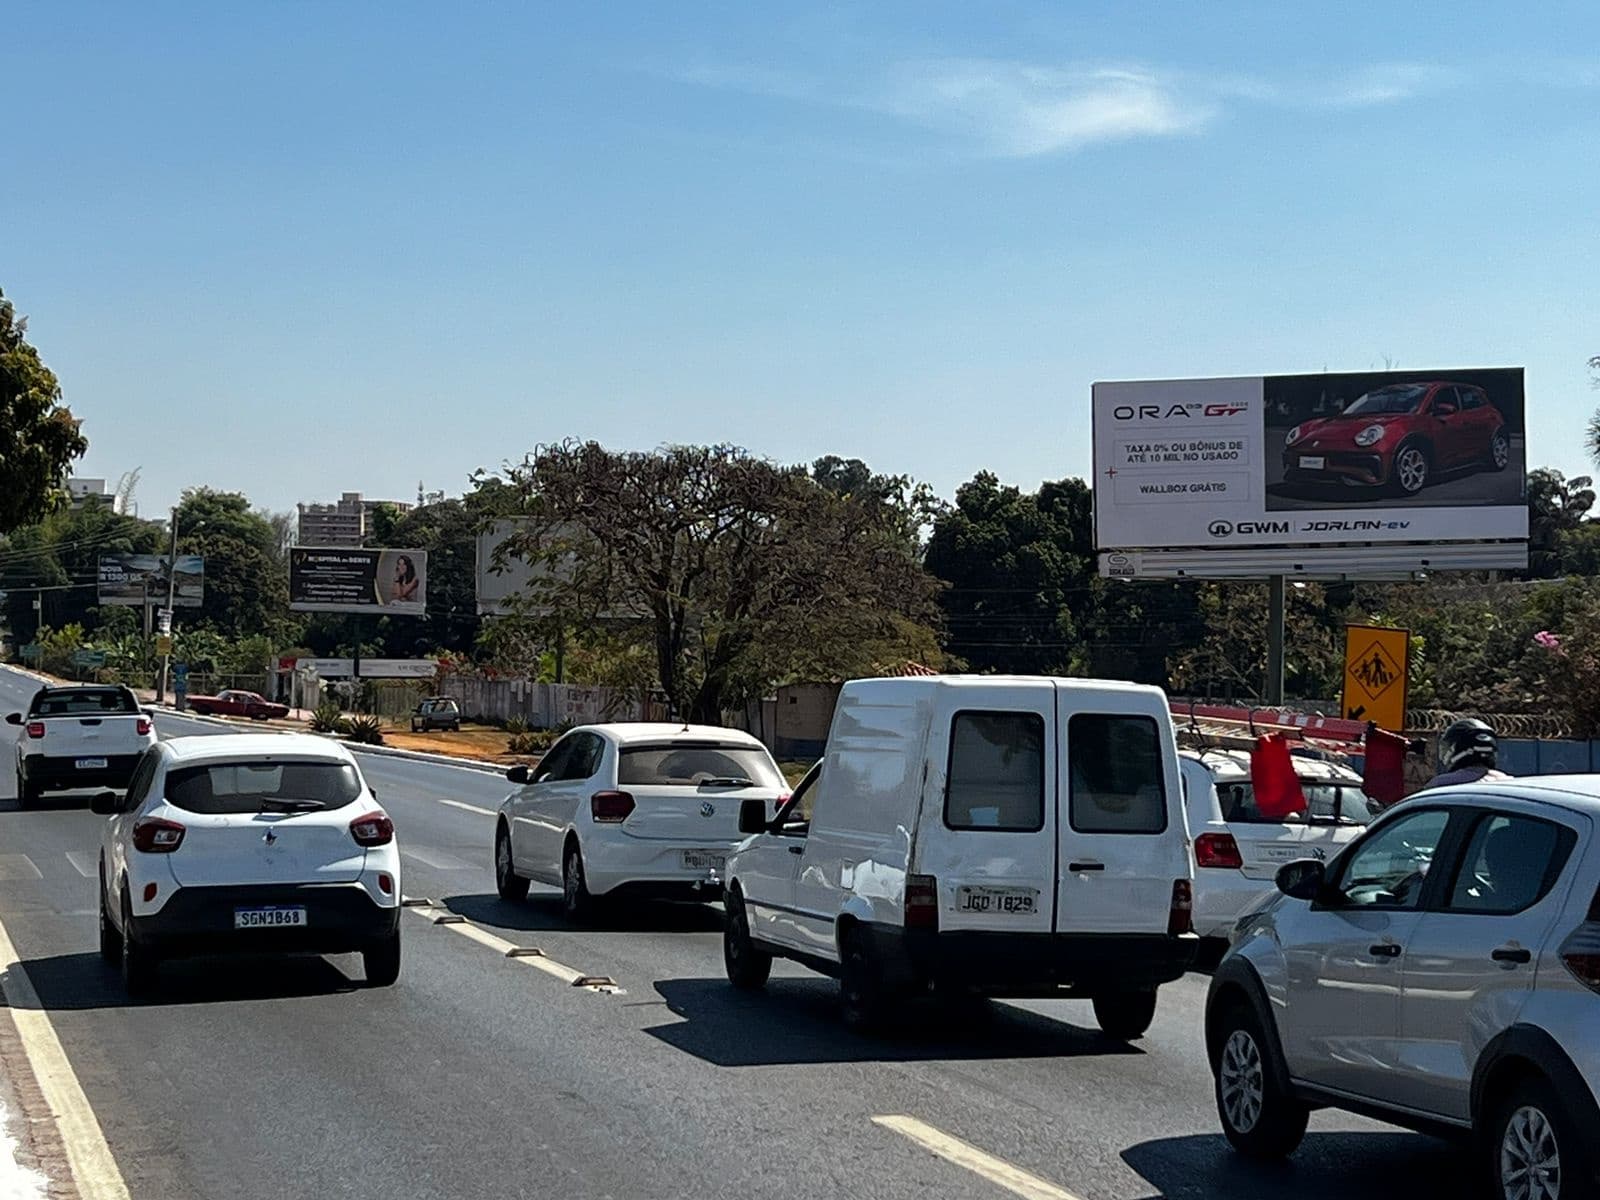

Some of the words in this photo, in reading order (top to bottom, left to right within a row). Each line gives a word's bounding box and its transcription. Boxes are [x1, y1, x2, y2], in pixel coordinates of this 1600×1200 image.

[1114, 404, 1190, 420] ORA
[1124, 444, 1151, 453] TAXA
[1154, 443, 1168, 452] 0%
[1171, 442, 1187, 452] OU
[1189, 441, 1226, 451] BÔNUS
[1229, 441, 1243, 450] DE
[1127, 453, 1147, 463] ATÉ
[1150, 454, 1161, 462] 10
[1163, 453, 1180, 462] MIL
[1183, 452, 1199, 461] NO
[1201, 450, 1239, 460] USADO
[1139, 485, 1187, 494] WALLBOX
[1189, 482, 1226, 493] GRÁTIS
[1237, 521, 1289, 534] GWM
[998, 896, 1032, 911] 1829
